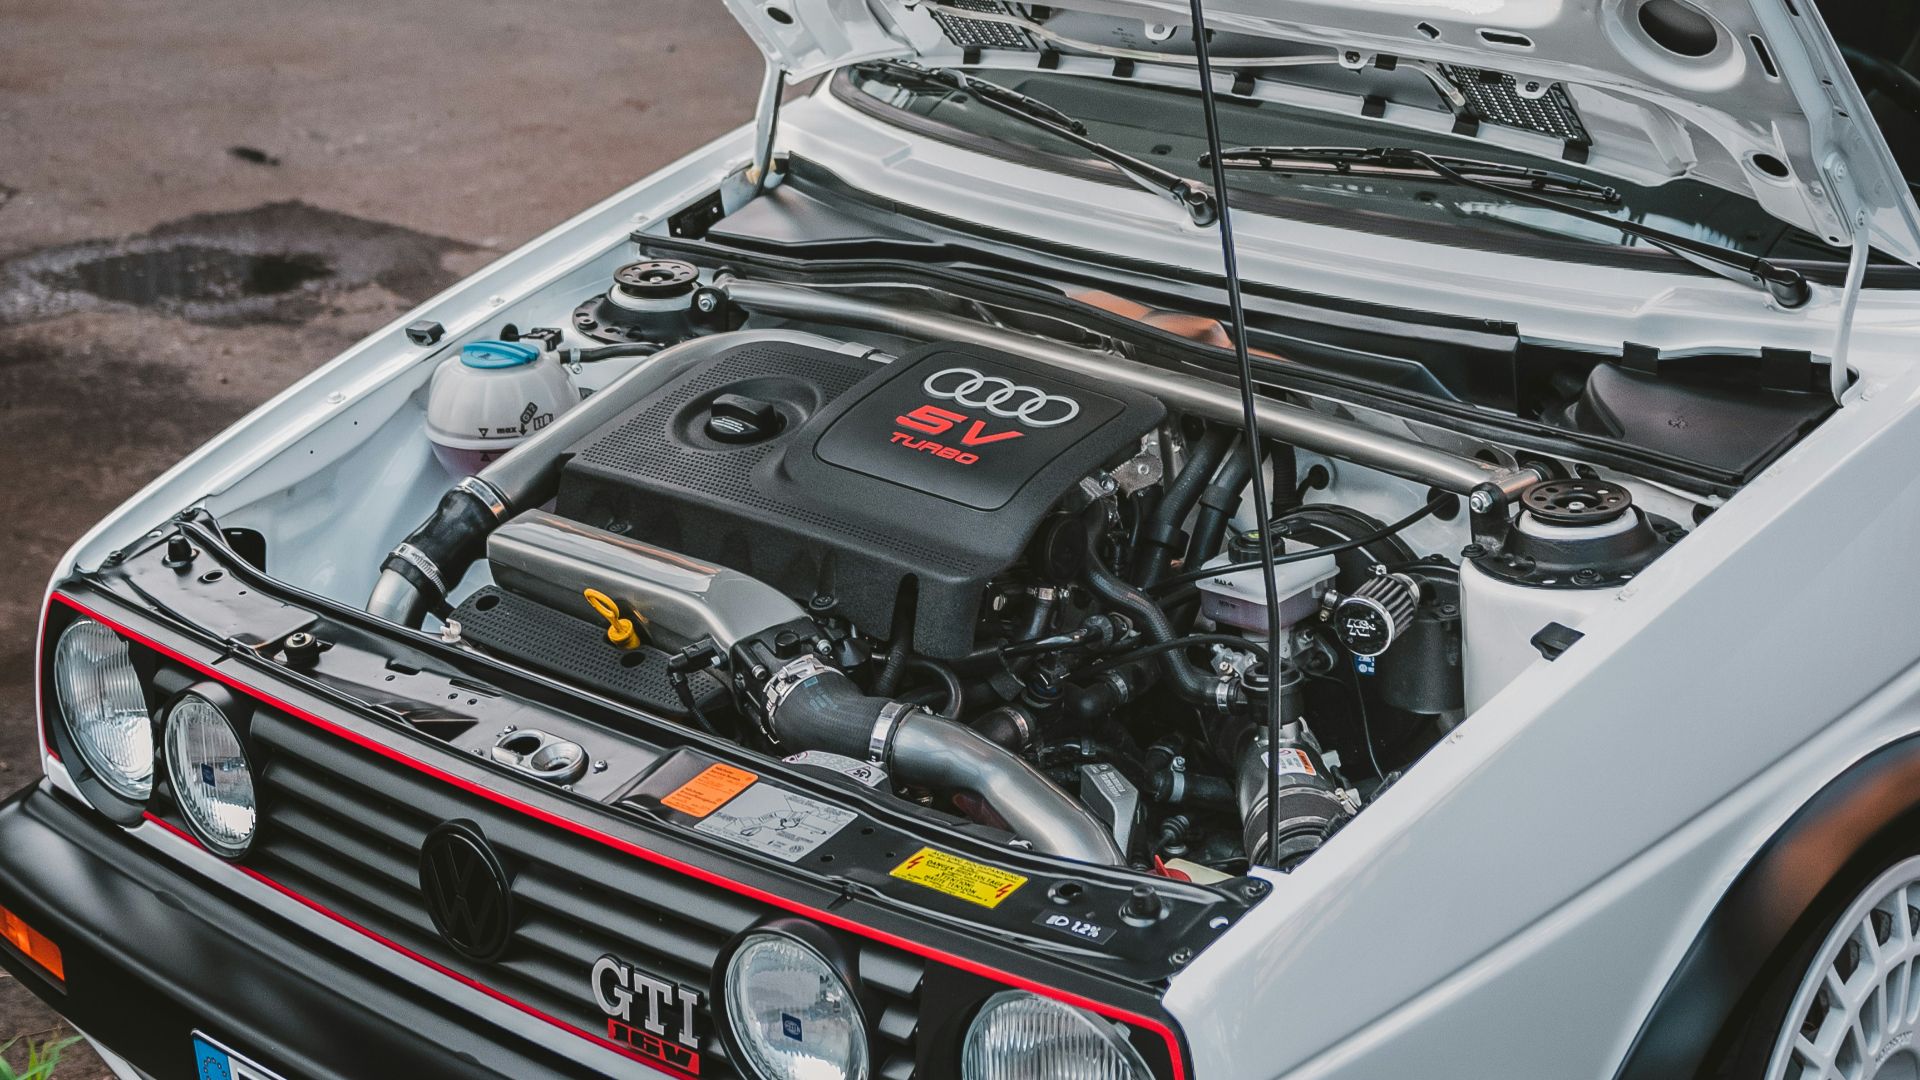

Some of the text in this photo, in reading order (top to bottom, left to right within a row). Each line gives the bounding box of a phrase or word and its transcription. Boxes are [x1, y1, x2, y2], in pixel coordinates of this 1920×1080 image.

[496, 426, 517, 435] max
[890, 431, 981, 465] TURBO
[926, 859, 954, 871] DANGER
[974, 874, 1004, 887] VOLTAGE
[948, 881, 977, 895] TENSION
[591, 955, 700, 1050] GTI
[610, 1020, 698, 1072] 16V
